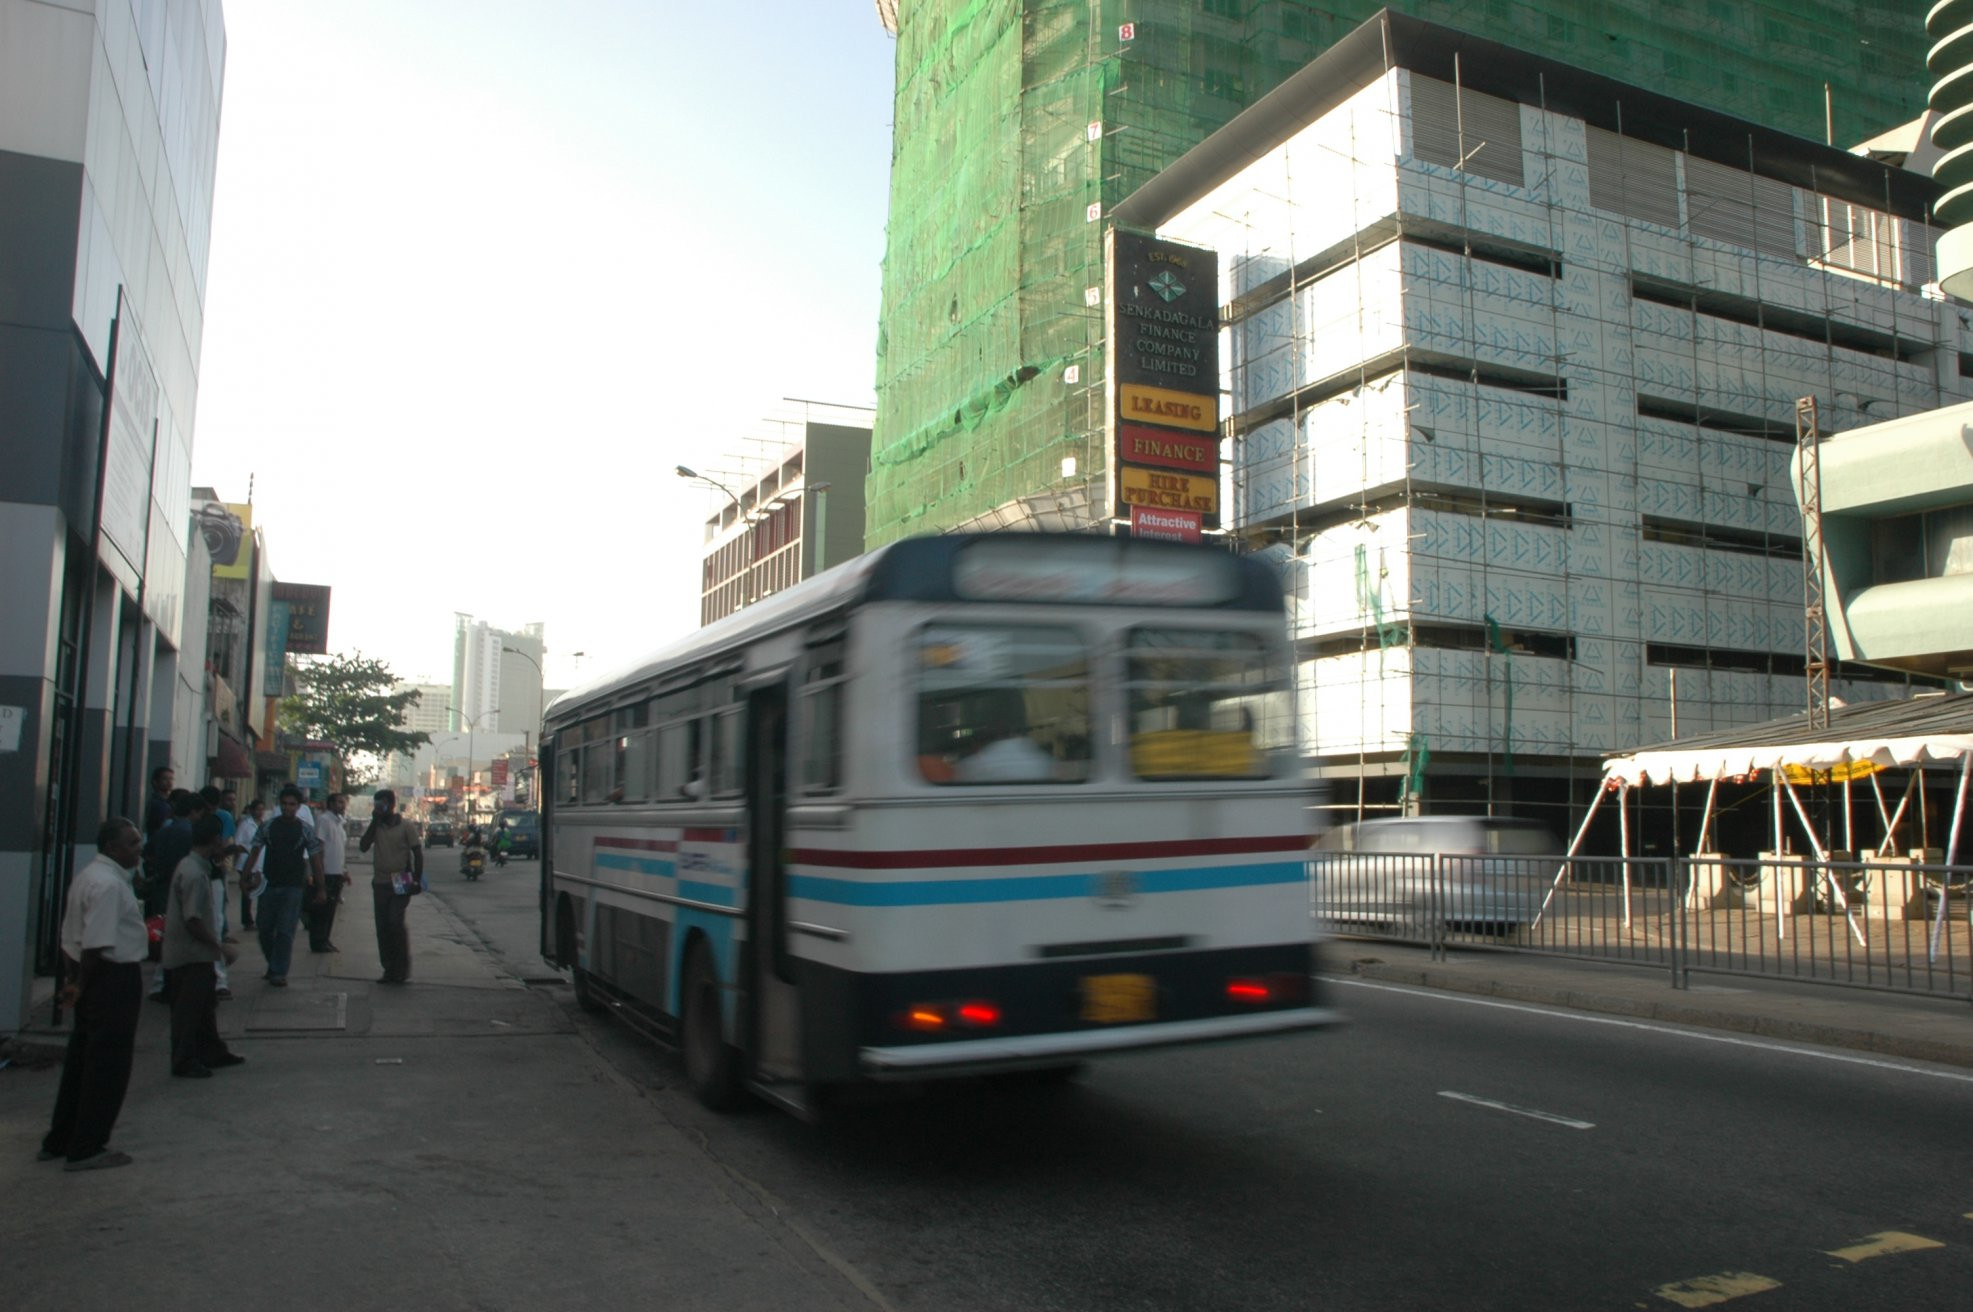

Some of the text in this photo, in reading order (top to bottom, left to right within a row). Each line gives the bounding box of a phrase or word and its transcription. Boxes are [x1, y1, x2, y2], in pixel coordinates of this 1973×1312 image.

[1121, 25, 1132, 40] 8
[1090, 124, 1099, 139] 7
[1089, 205, 1098, 219] 6
[1088, 289, 1098, 303] 5
[1119, 303, 1215, 330] SENKADAGALA
[1139, 323, 1197, 344] FINANCE
[1136, 339, 1201, 361] COMPANY
[1067, 367, 1077, 382] 4
[1141, 356, 1197, 377] LIMITED
[1131, 395, 1202, 421] LEASING
[1133, 437, 1206, 462] FINANCE
[1150, 474, 1190, 493] HIRE
[1125, 486, 1212, 510] PURCHASE
[1138, 512, 1197, 530] Attractive
[1138, 527, 1183, 541] Interest
